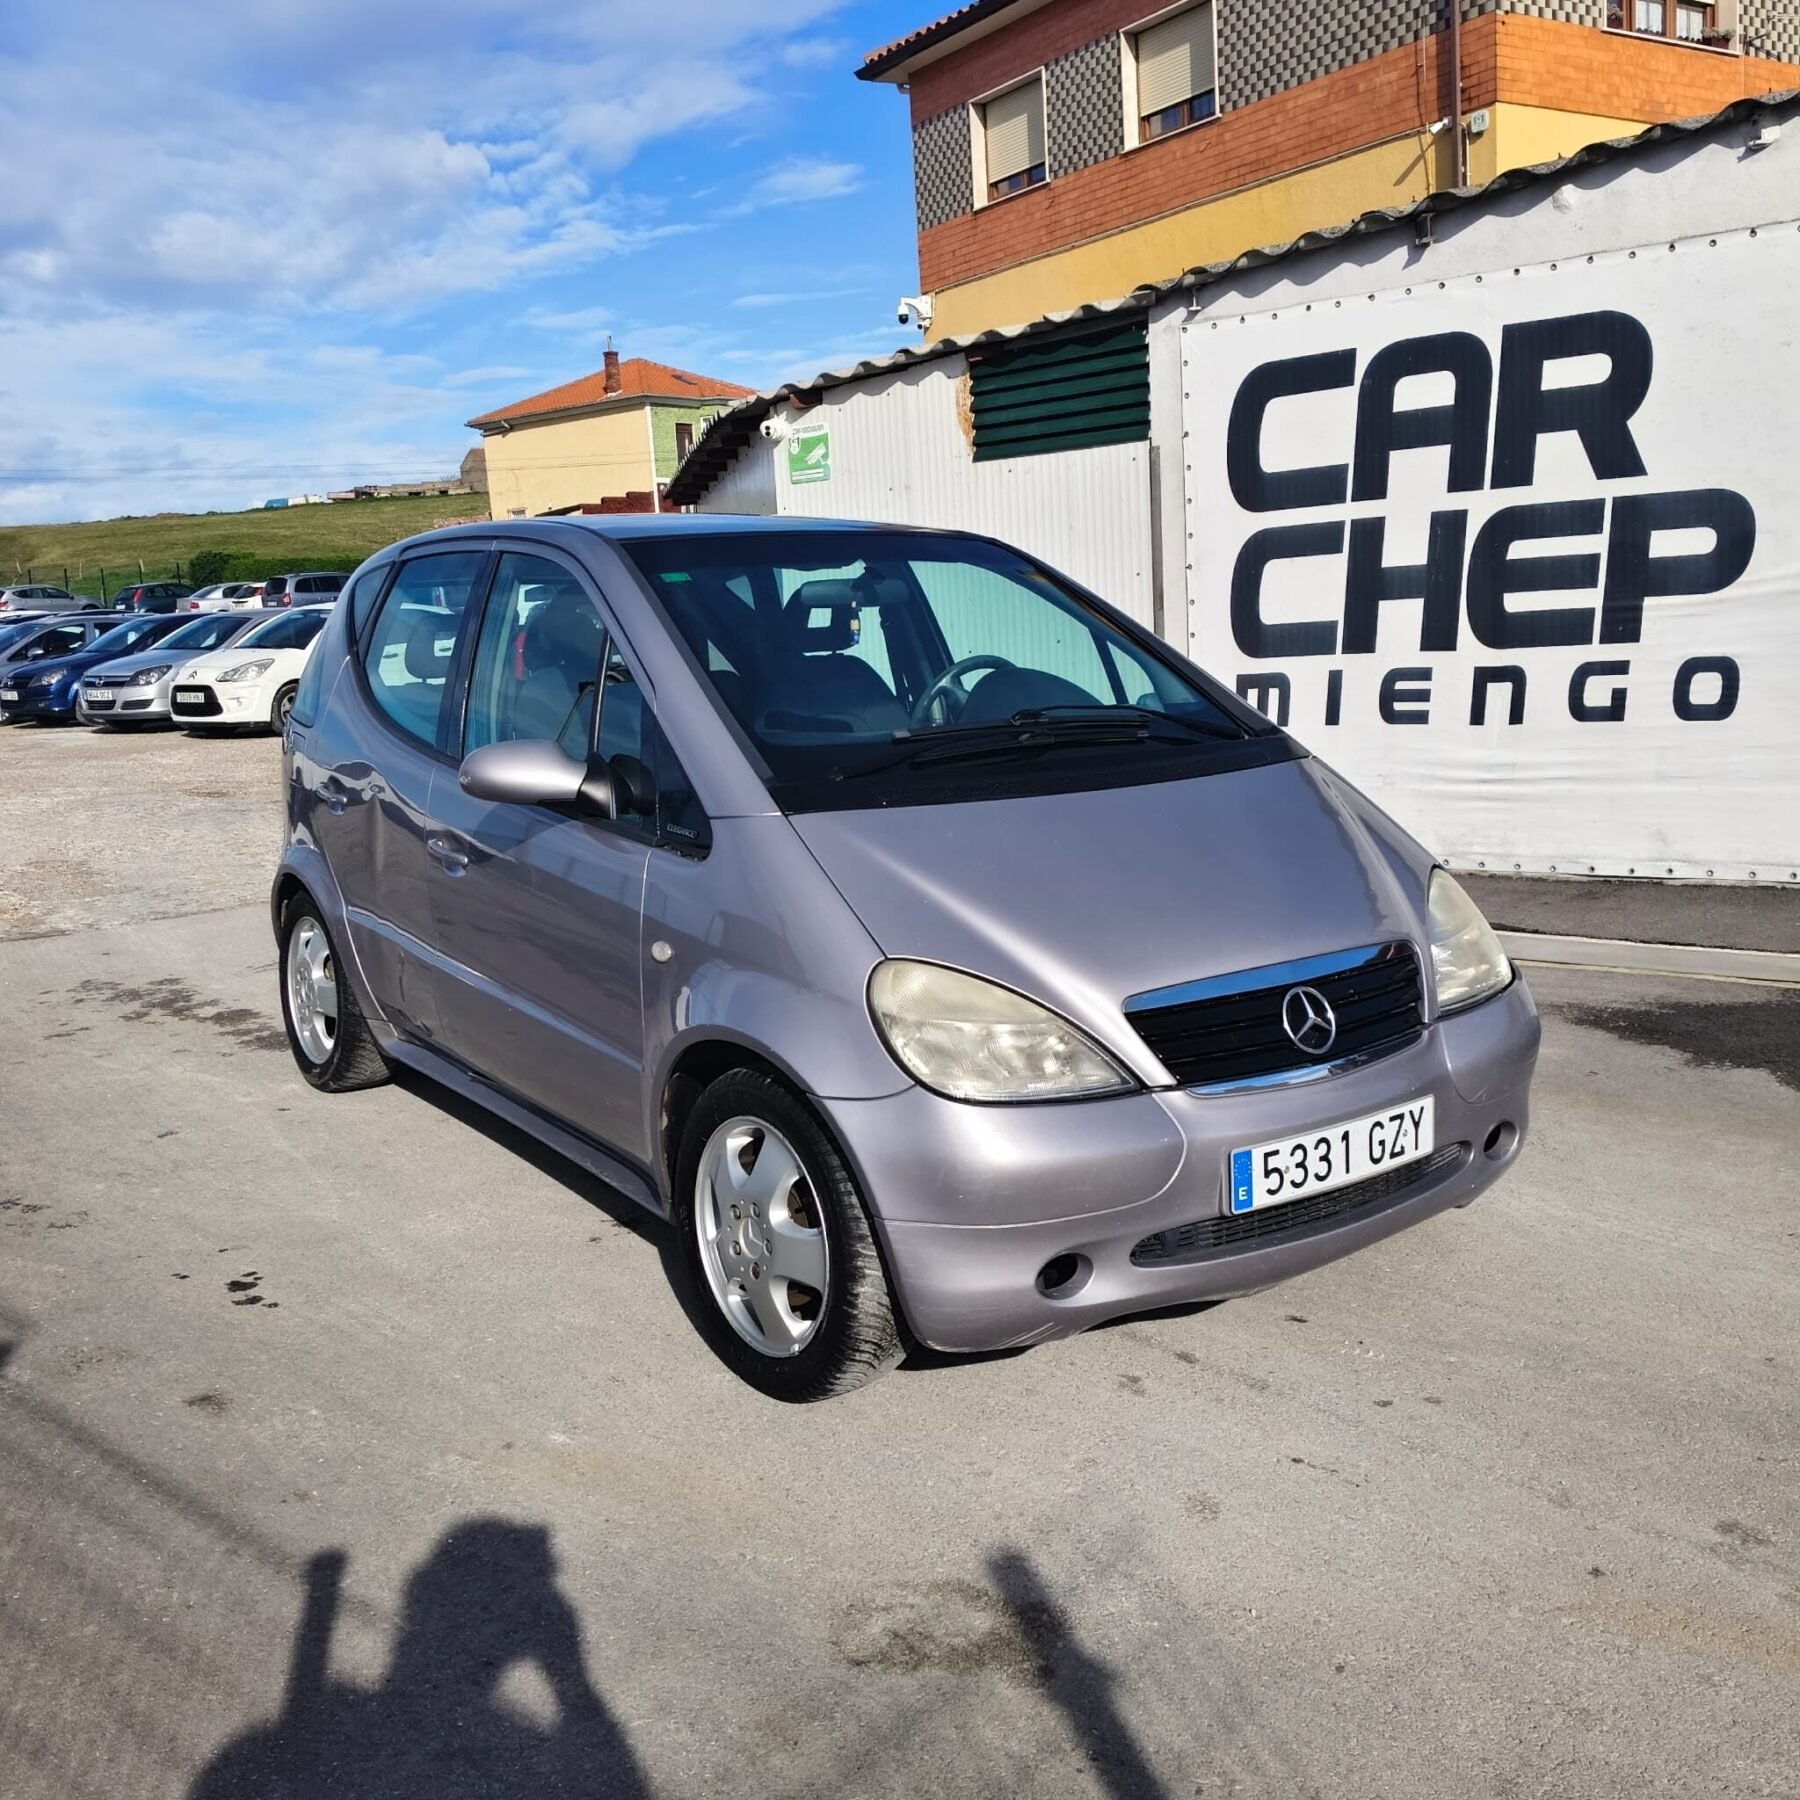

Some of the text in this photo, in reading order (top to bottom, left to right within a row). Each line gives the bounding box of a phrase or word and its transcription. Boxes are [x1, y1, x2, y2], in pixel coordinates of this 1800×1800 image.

[1227, 310, 1653, 513] CAR
[1230, 488, 1756, 658] CHEP
[1235, 656, 1740, 727] MIENGO
[667, 823, 698, 838] ELEGANCE
[1263, 1106, 1425, 1196] 5331 GZY
[1238, 1186, 1248, 1200] E
